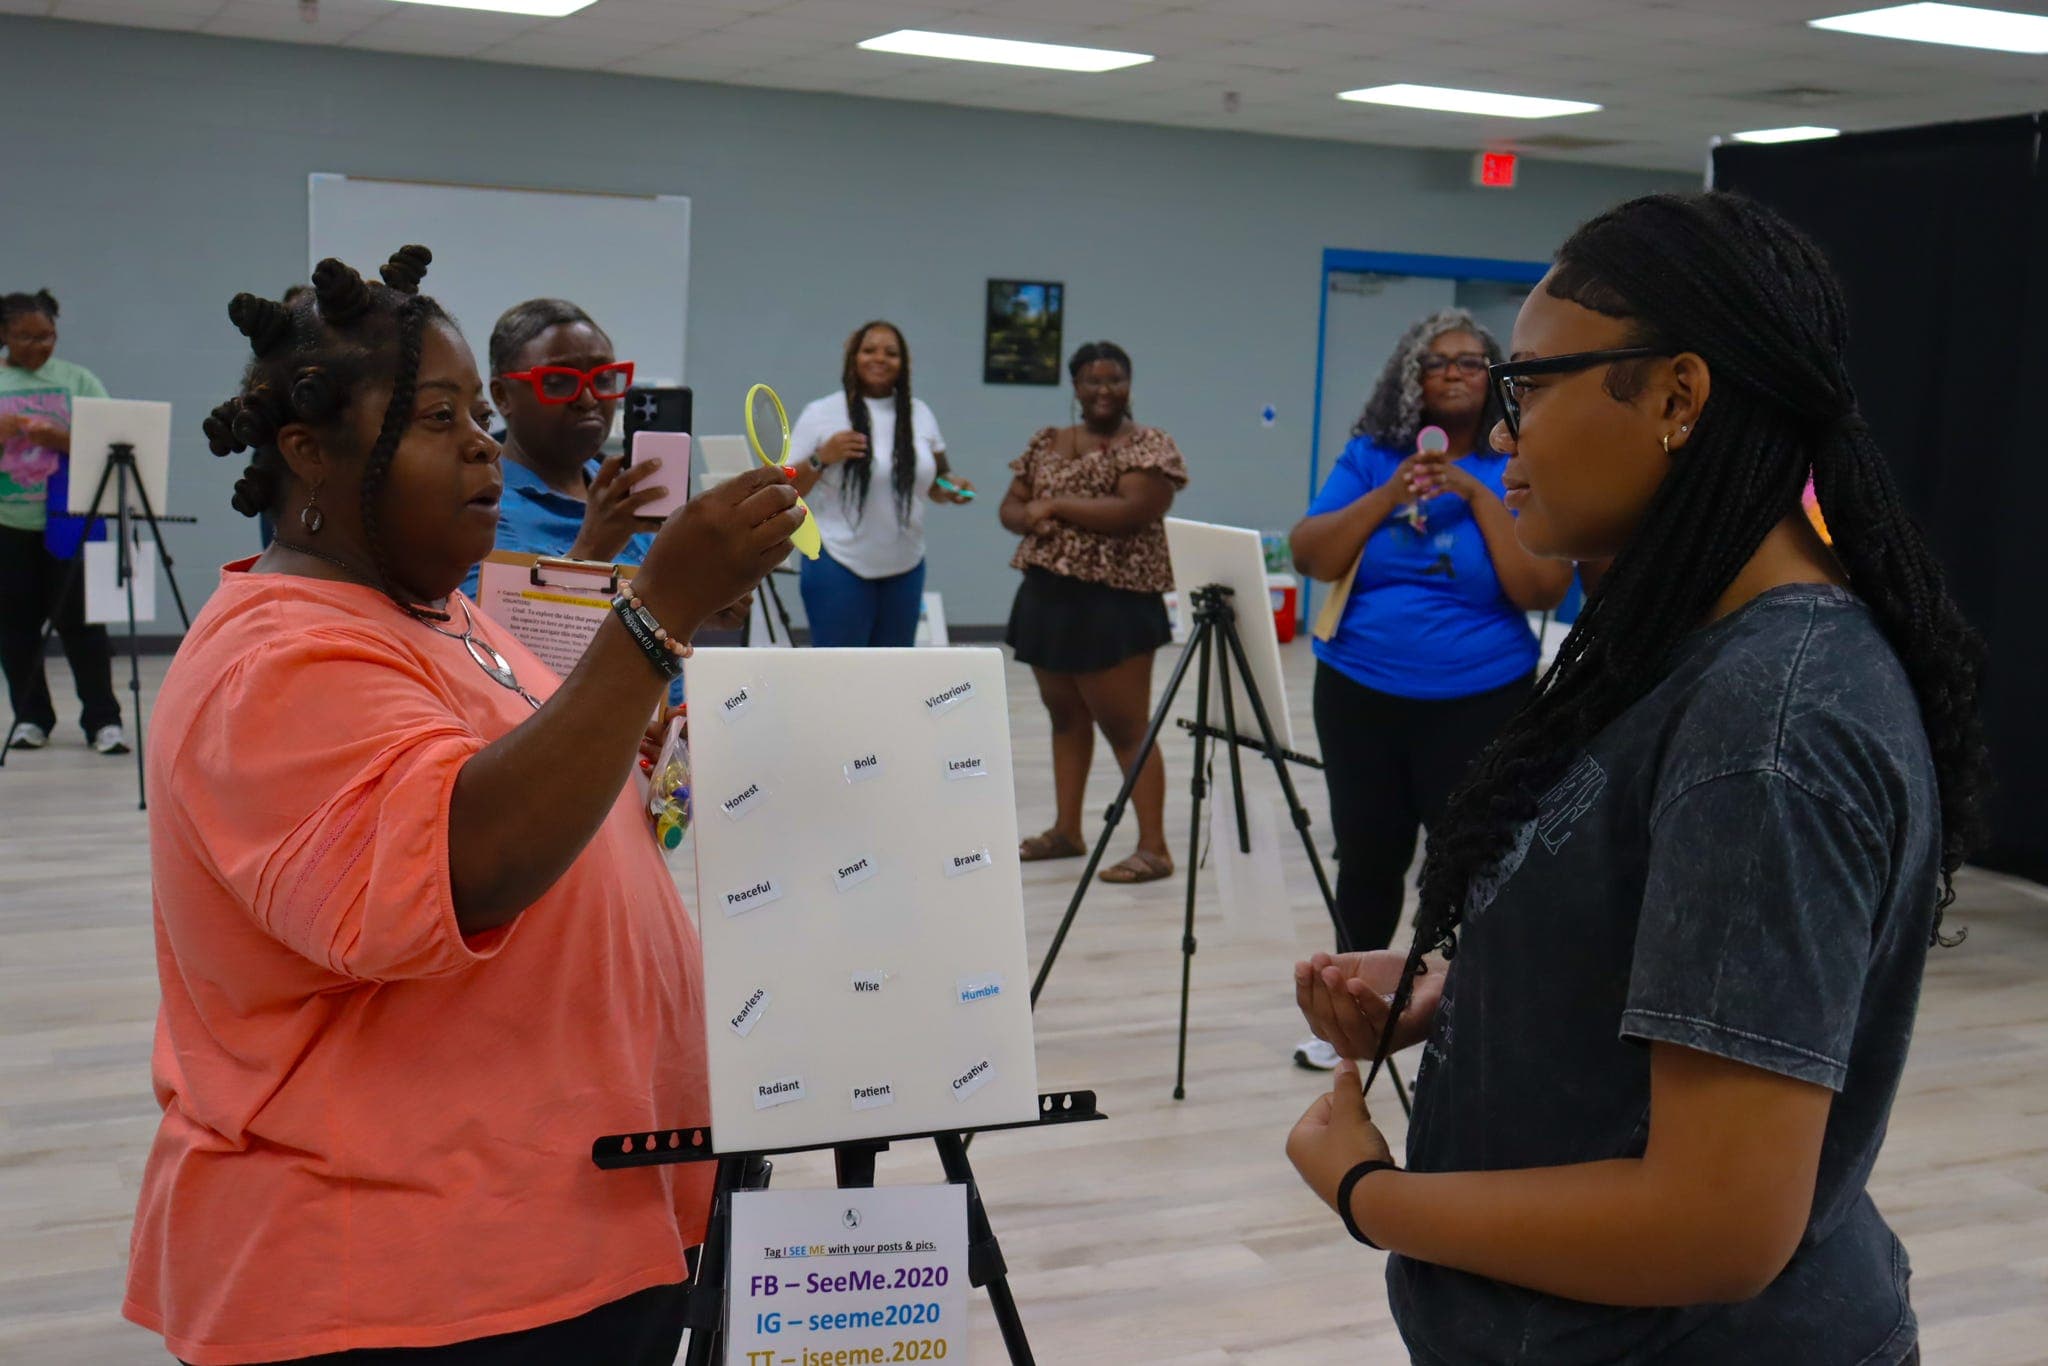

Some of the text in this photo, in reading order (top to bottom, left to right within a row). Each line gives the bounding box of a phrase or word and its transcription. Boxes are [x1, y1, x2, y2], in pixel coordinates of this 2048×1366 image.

[725, 690, 748, 711] Kind
[925, 680, 972, 709] Victorious
[854, 754, 877, 770] Bold
[948, 757, 982, 771] Leader
[725, 783, 759, 811] Honest
[838, 858, 868, 879] Smart
[953, 852, 982, 867] Brave
[727, 881, 772, 905] Peaceful
[854, 980, 880, 992] Wise
[961, 984, 1000, 1001] Humble
[731, 987, 764, 1028] Fearless
[952, 1059, 989, 1090] Creative
[758, 1080, 800, 1097] Radiant
[853, 1084, 890, 1099] Patient
[764, 1240, 936, 1258] Tag I SEE ME with your posts & pics.
[750, 1275, 779, 1297] FB
[806, 1266, 949, 1294] SeeMe.2020
[756, 1312, 781, 1334] IG
[808, 1302, 941, 1331] seeme2020
[746, 1350, 776, 1366] TT
[803, 1338, 947, 1366] iseeme.2020
